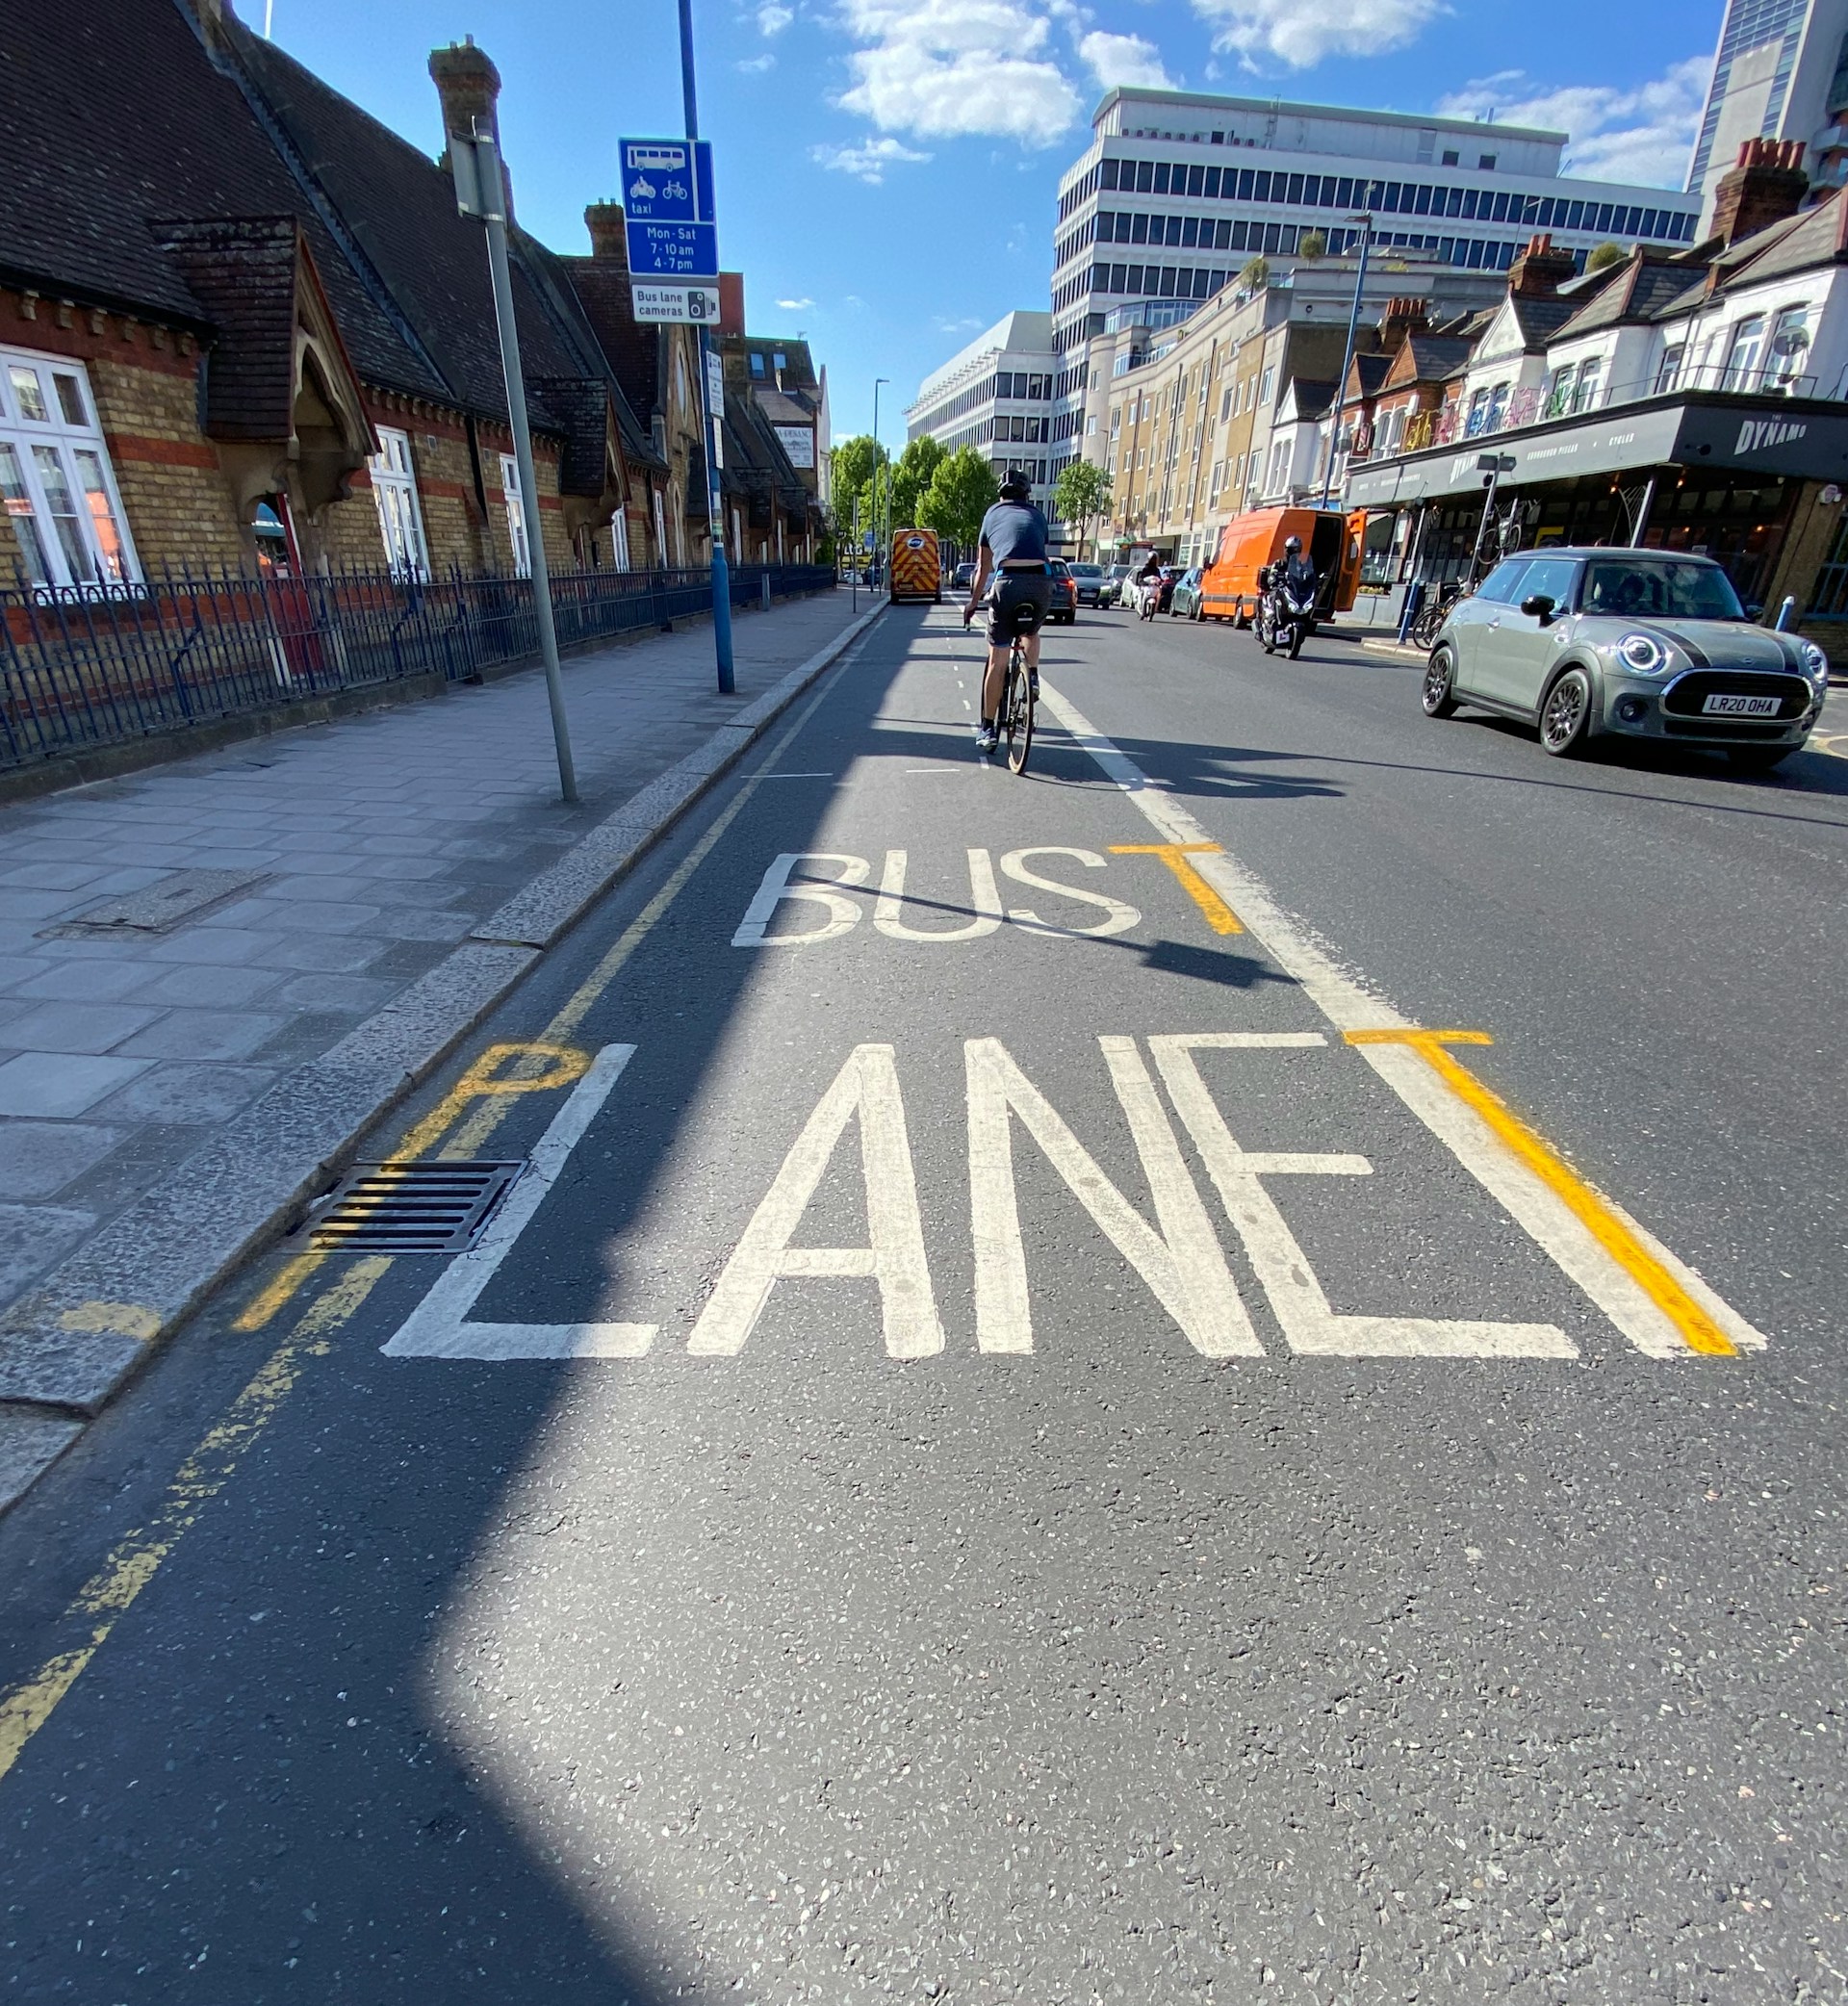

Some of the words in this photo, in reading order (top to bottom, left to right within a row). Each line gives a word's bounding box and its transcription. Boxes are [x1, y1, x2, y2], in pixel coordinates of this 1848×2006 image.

[631, 202, 652, 214] taxi
[647, 227, 670, 239] Mon
[678, 227, 696, 240] Sat
[679, 246, 694, 256] am
[678, 260, 693, 271] pm
[637, 291, 657, 302] Bus
[660, 292, 682, 303] lane
[639, 307, 682, 317] cameras
[1733, 420, 1808, 455] DYNAMO
[1709, 697, 1747, 711] LR20
[1748, 699, 1774, 712] OHA
